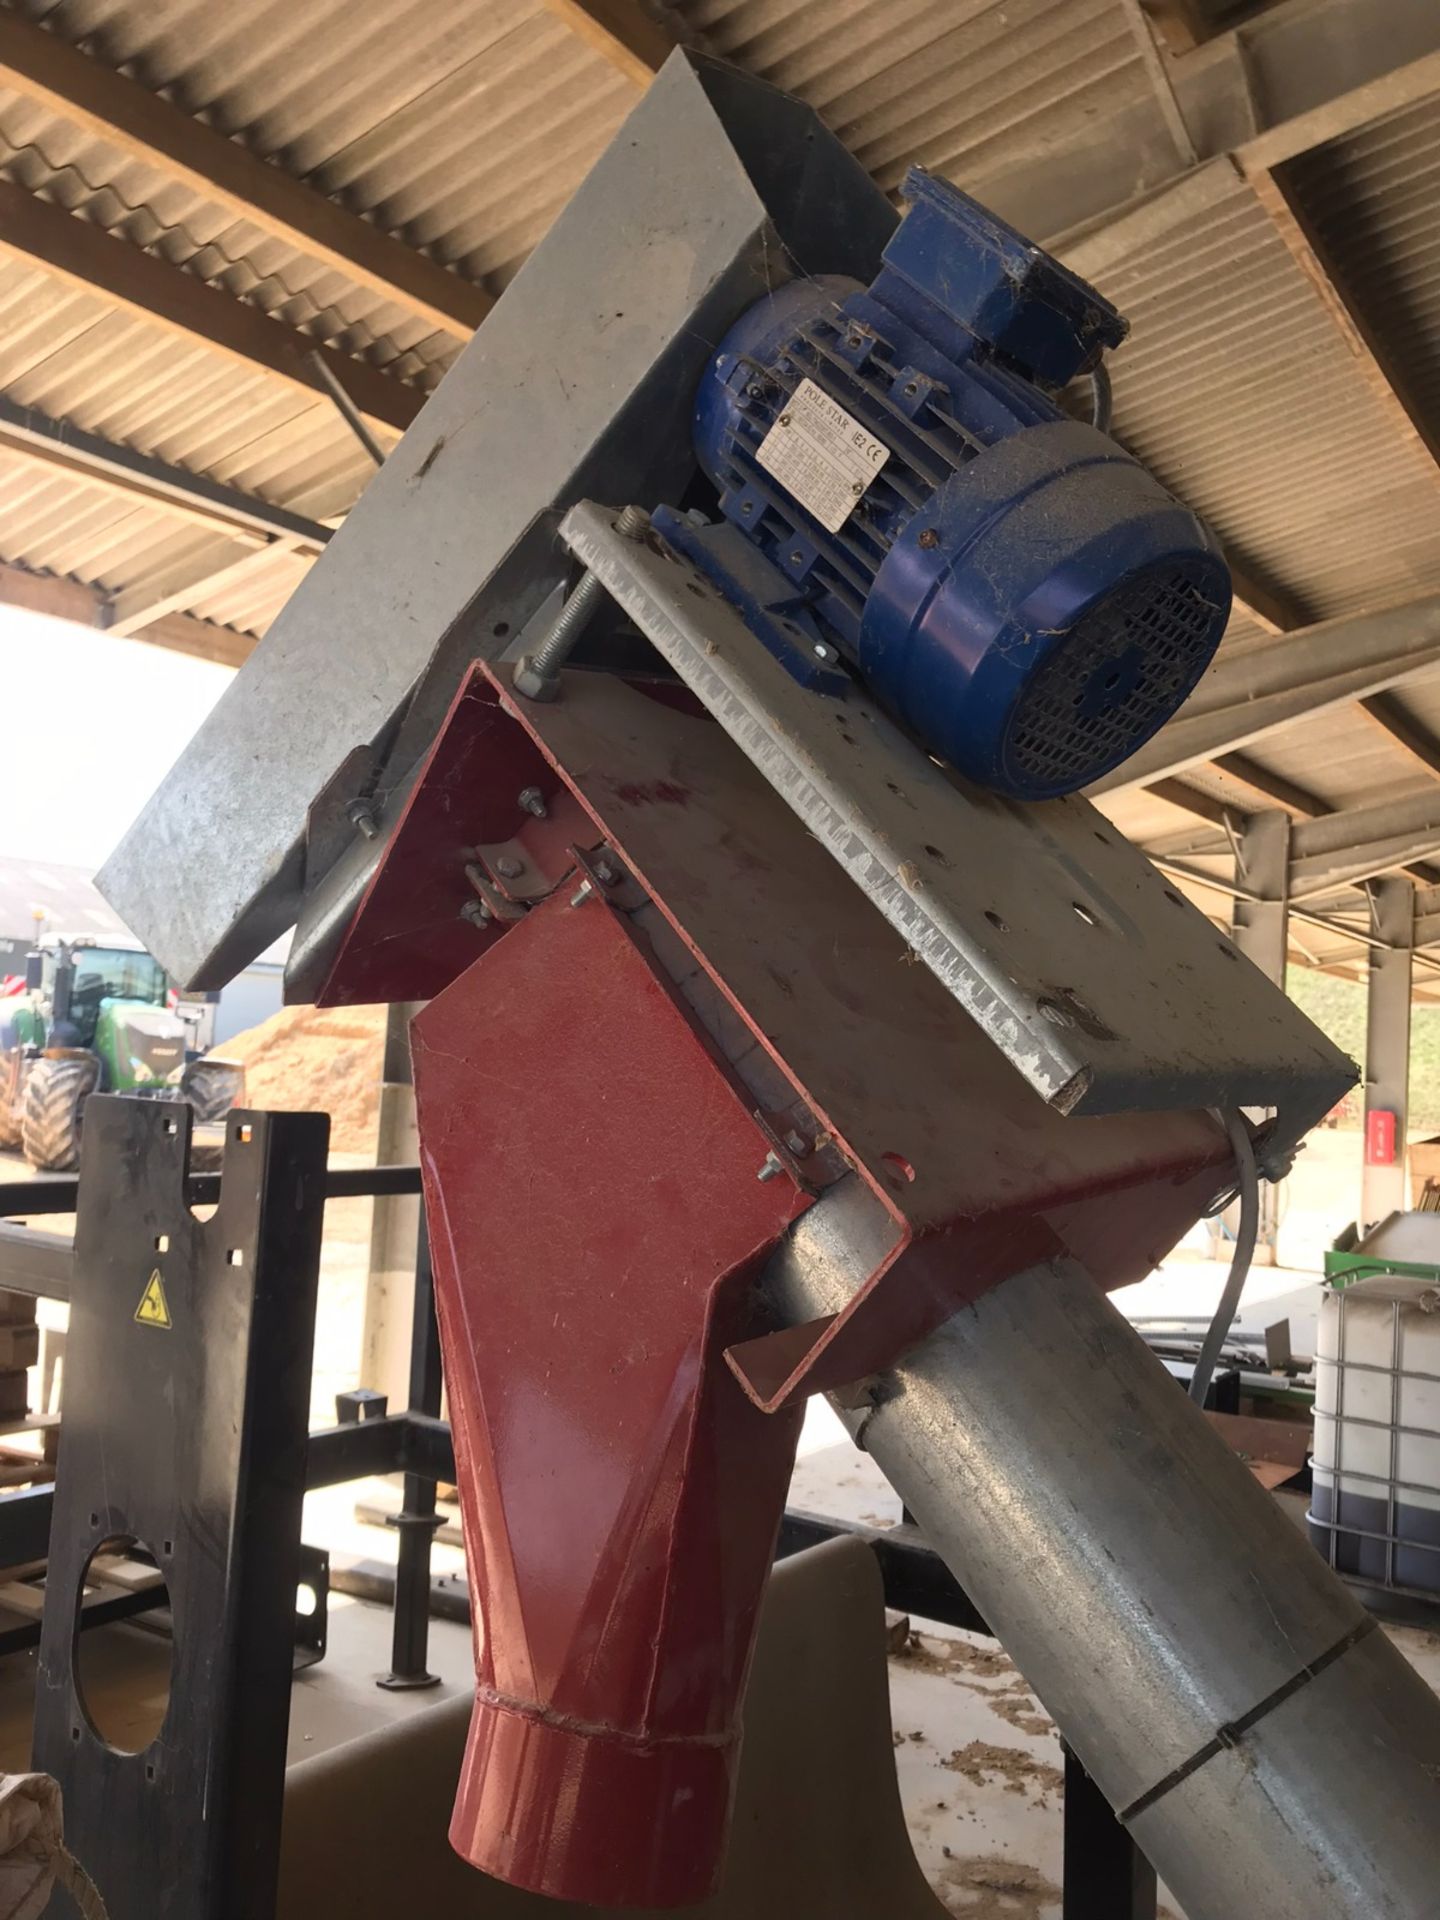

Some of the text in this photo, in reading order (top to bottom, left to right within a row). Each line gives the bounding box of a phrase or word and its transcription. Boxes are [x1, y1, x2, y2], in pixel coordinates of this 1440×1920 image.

[804, 386, 827, 410] POLE
[826, 406, 849, 430] STAR
[851, 431, 867, 449] IE2
